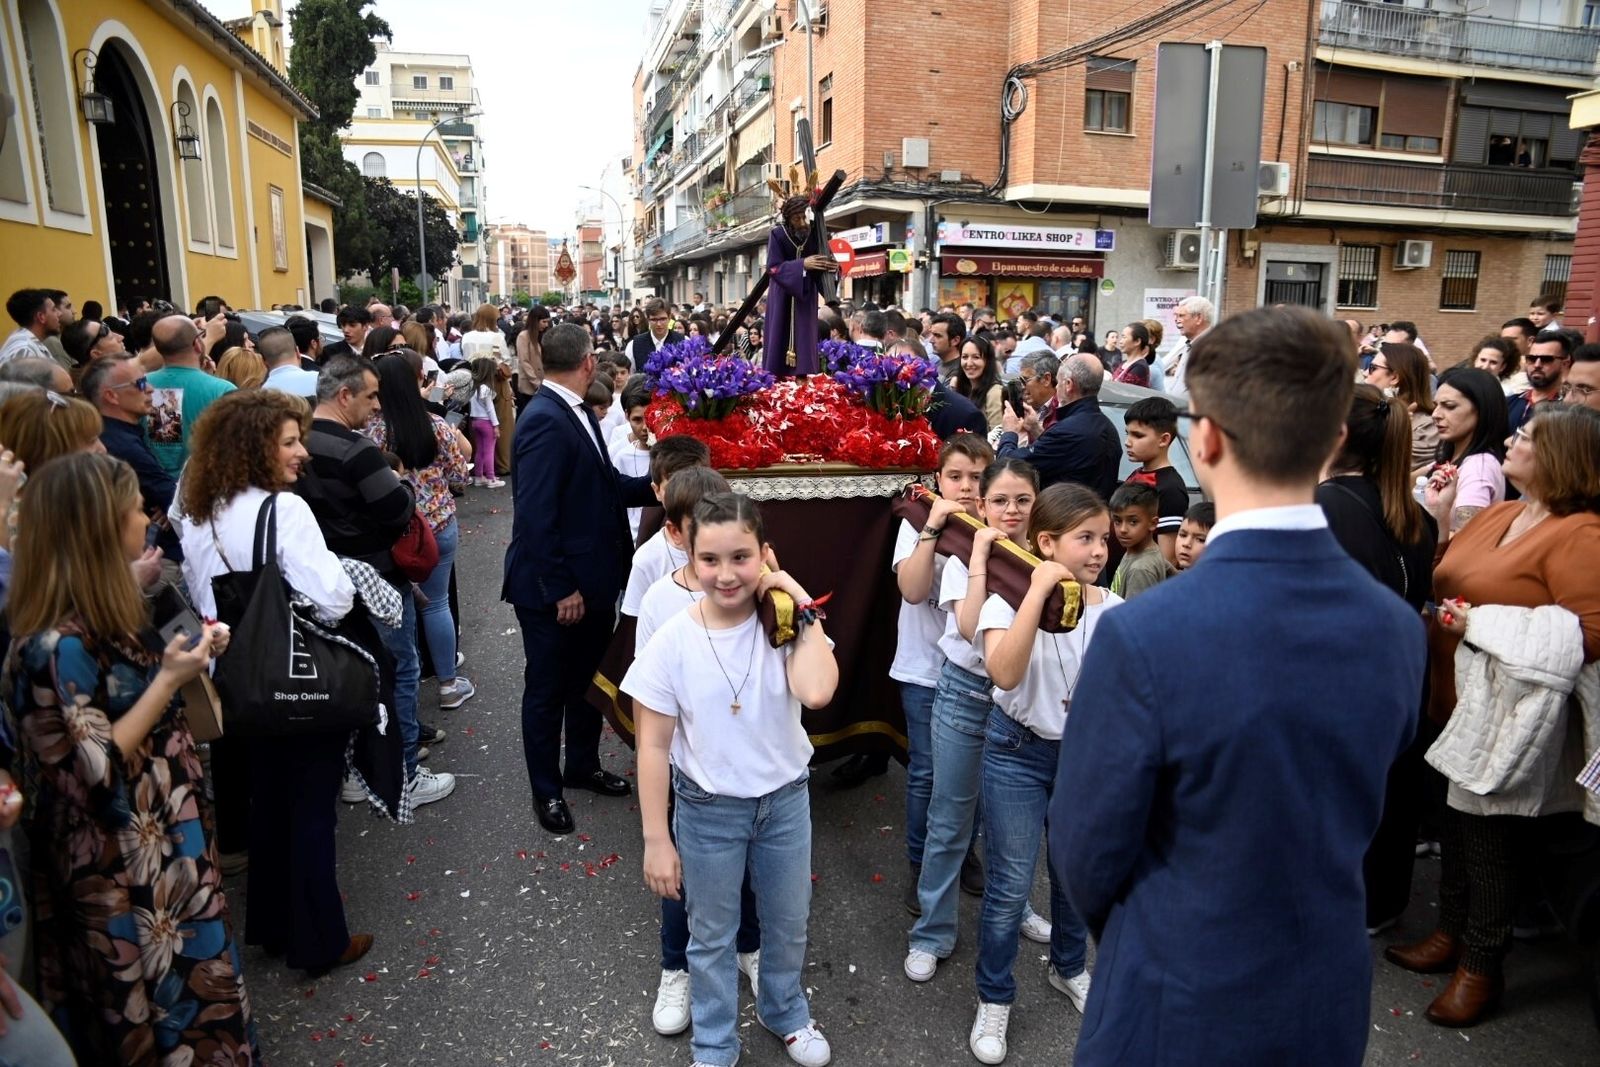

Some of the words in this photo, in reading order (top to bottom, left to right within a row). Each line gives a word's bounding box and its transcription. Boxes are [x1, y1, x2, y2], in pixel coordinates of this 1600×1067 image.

[961, 229, 1042, 242] CENTROCLIKEA
[1045, 233, 1073, 243] SHOP
[1075, 232, 1083, 246] 2
[991, 262, 1000, 271] El
[1001, 264, 1017, 273] pan
[1017, 264, 1048, 272] nuestro
[1048, 264, 1059, 272] de
[1060, 264, 1080, 273] cada
[274, 692, 299, 701] Shop
[300, 692, 330, 700] Online
